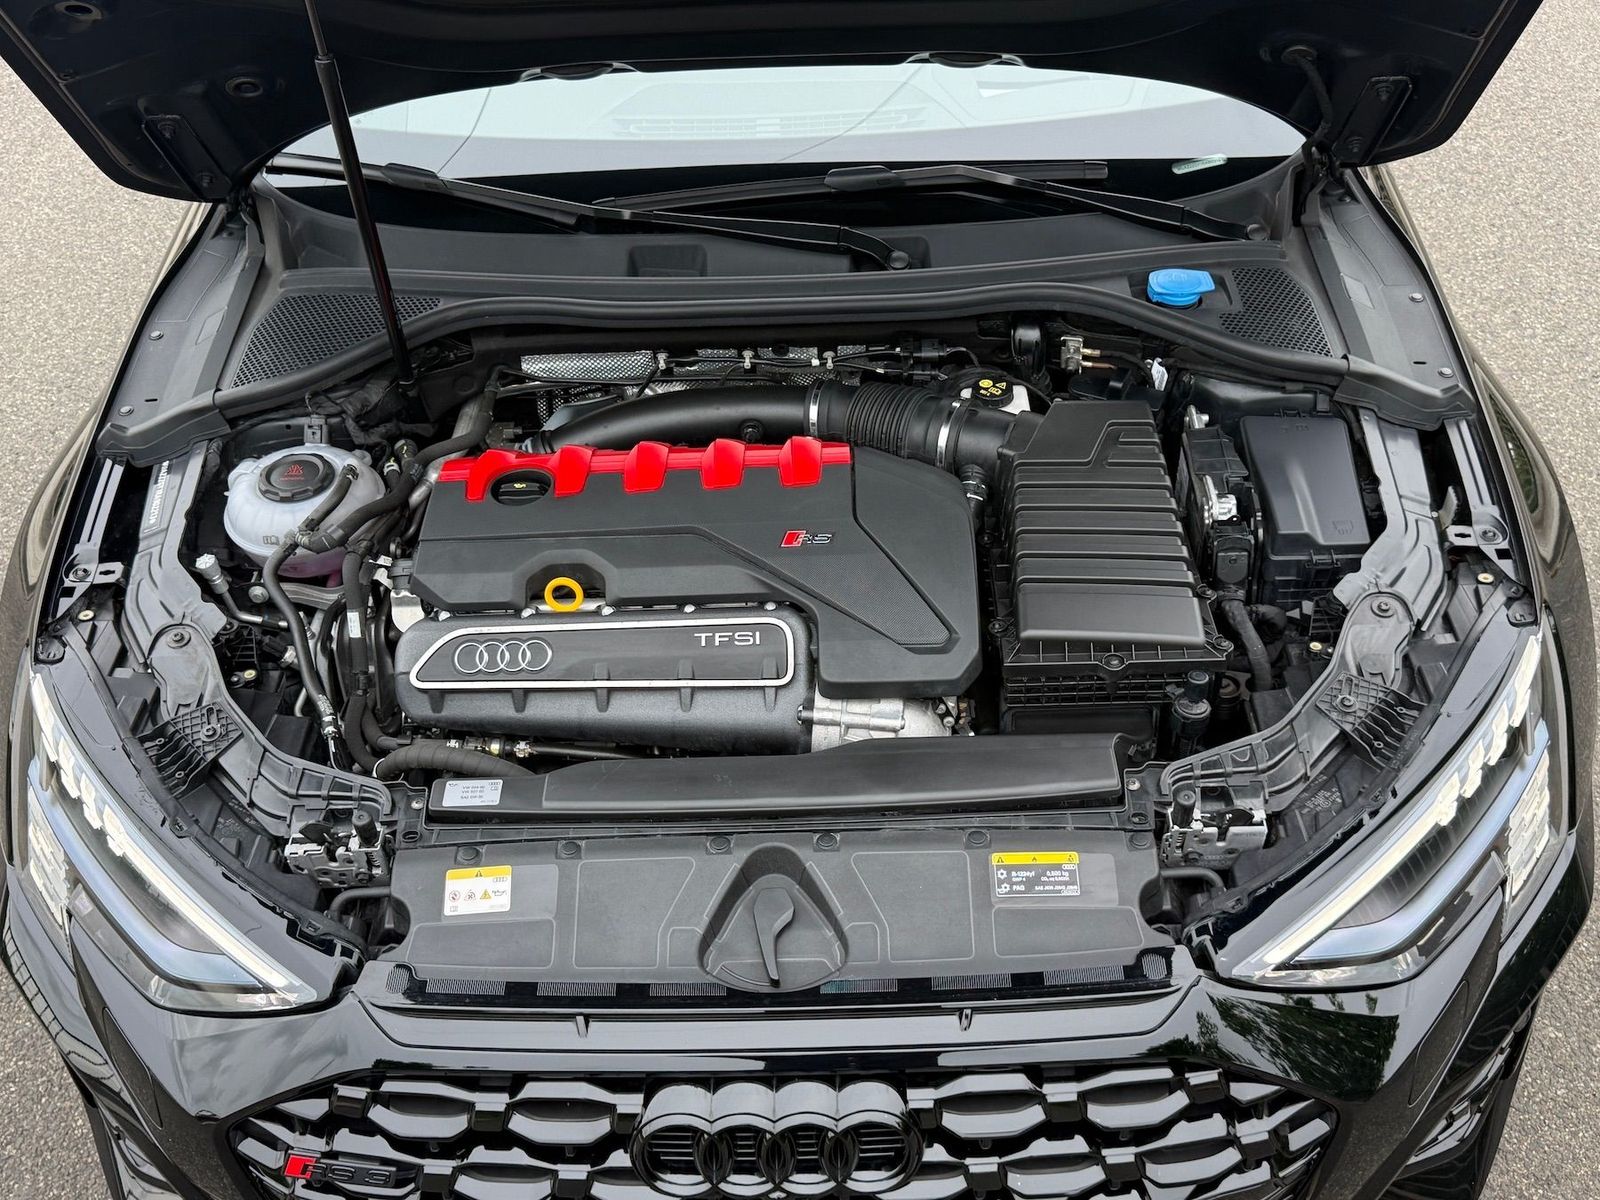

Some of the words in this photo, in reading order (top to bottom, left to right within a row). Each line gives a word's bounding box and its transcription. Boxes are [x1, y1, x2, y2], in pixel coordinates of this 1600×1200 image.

[790, 531, 833, 545] RS
[694, 631, 760, 647] TFSI
[295, 1161, 355, 1181] RS
